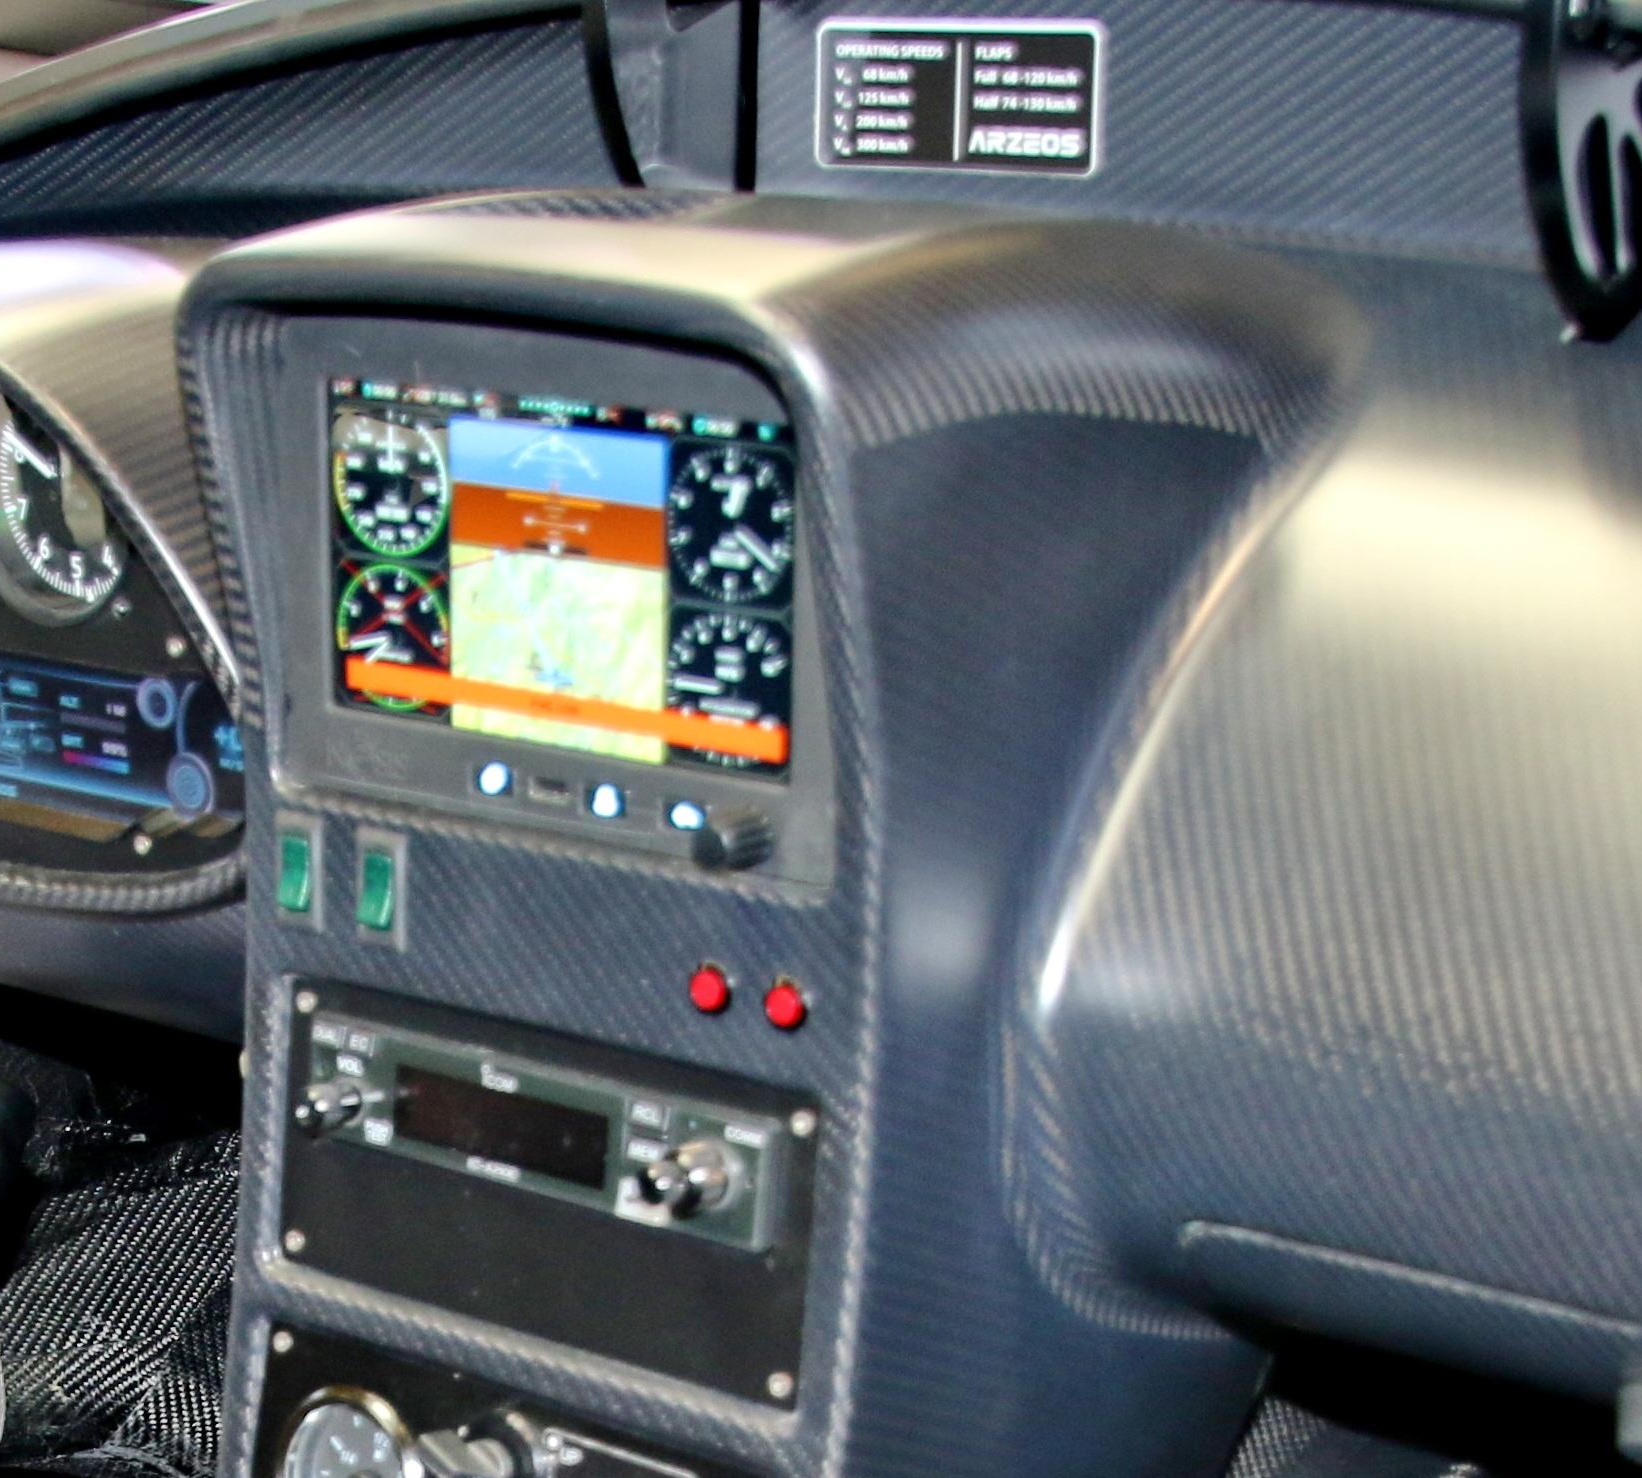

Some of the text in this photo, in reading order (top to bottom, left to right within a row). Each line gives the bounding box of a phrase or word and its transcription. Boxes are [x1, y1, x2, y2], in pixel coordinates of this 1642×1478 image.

[835, 43, 944, 59] OPERATING SPEEDS
[975, 46, 1012, 61] FLAPS
[877, 68, 908, 82] km/h
[974, 69, 997, 85] Full
[1046, 71, 1079, 88] km/h
[878, 90, 910, 107] km/h
[973, 94, 999, 111] Half
[1045, 96, 1078, 113] km/h
[877, 114, 908, 130] km/h
[877, 138, 908, 154] km/h
[968, 128, 1082, 157] ARZEOS
[17, 498, 29, 520] 7
[38, 535, 50, 558] 6
[70, 554, 83, 578] 5
[349, 1034, 369, 1052] EC
[336, 1055, 364, 1076] VOL
[558, 1446, 584, 1466] UP
